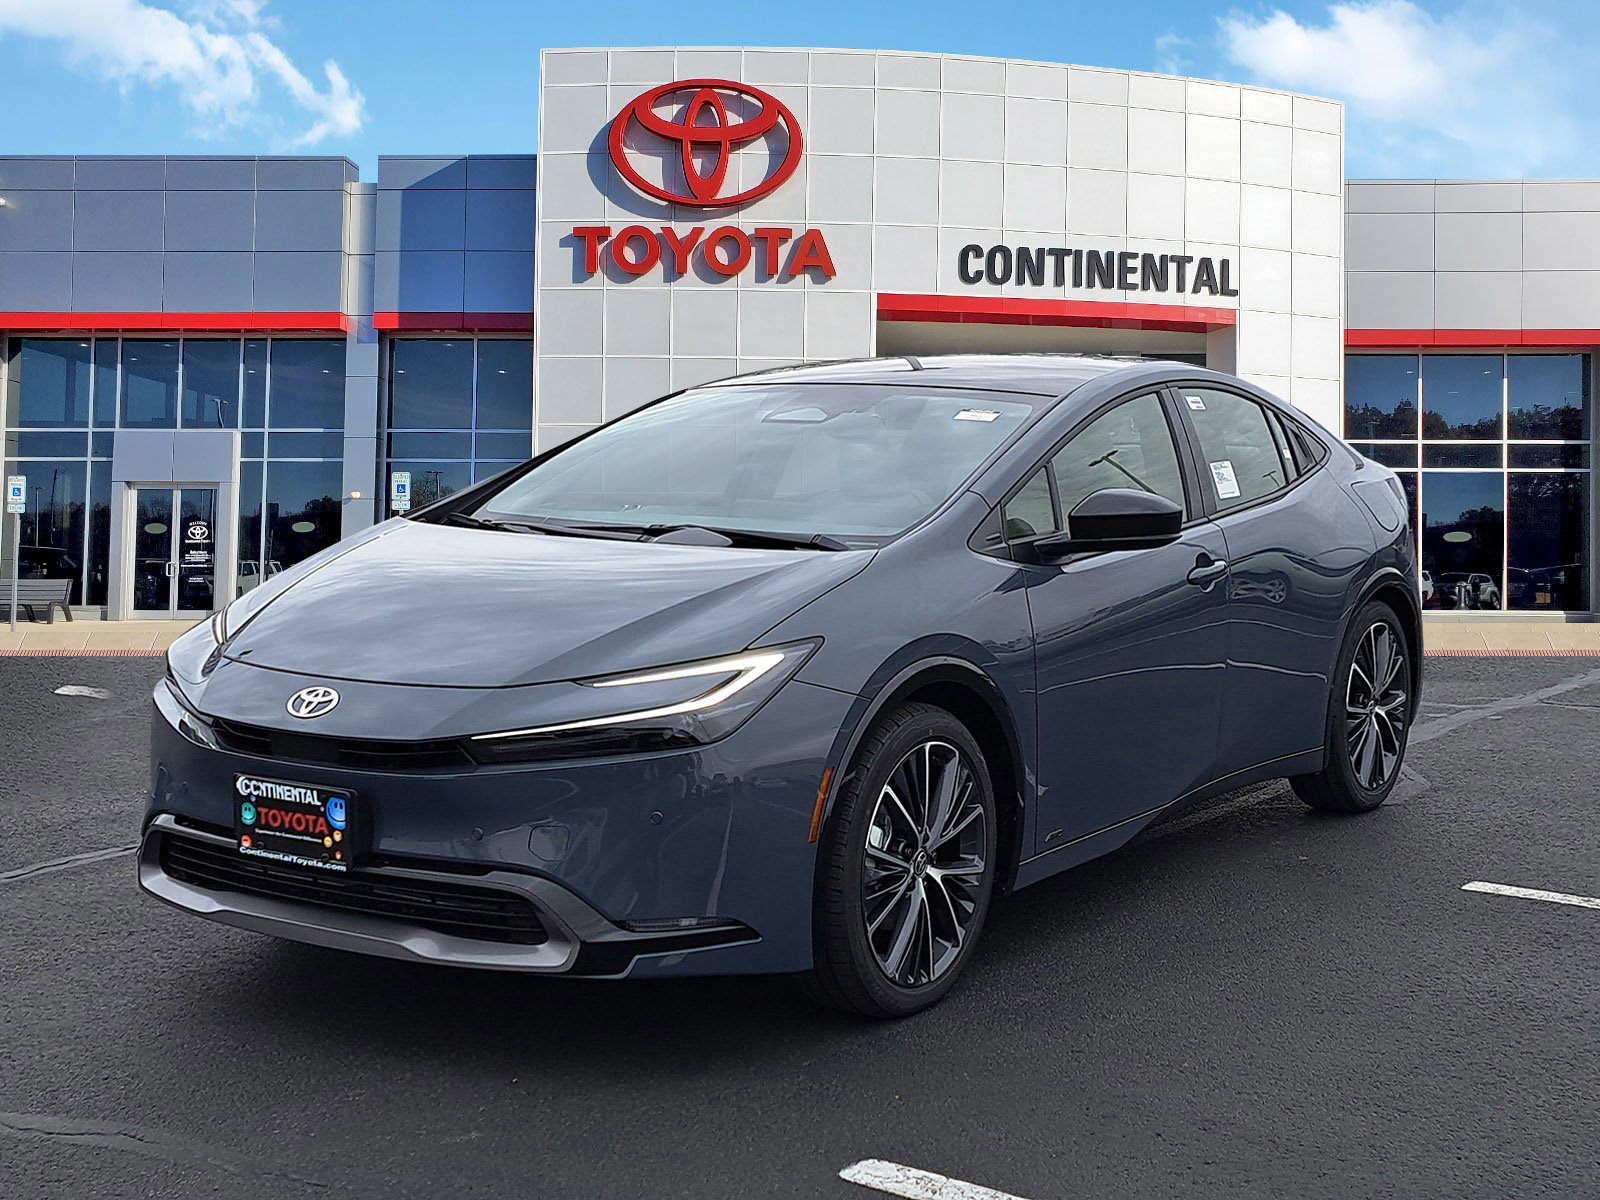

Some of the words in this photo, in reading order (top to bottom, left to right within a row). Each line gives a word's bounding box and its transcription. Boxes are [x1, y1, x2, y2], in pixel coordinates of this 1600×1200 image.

[572, 225, 837, 277] TOYOTA
[958, 244, 1239, 297] CONTINENTAL
[236, 776, 322, 806] CONTINENTAL
[257, 806, 330, 835] TOYOTA
[239, 846, 347, 872] ContinentalToyota.com
